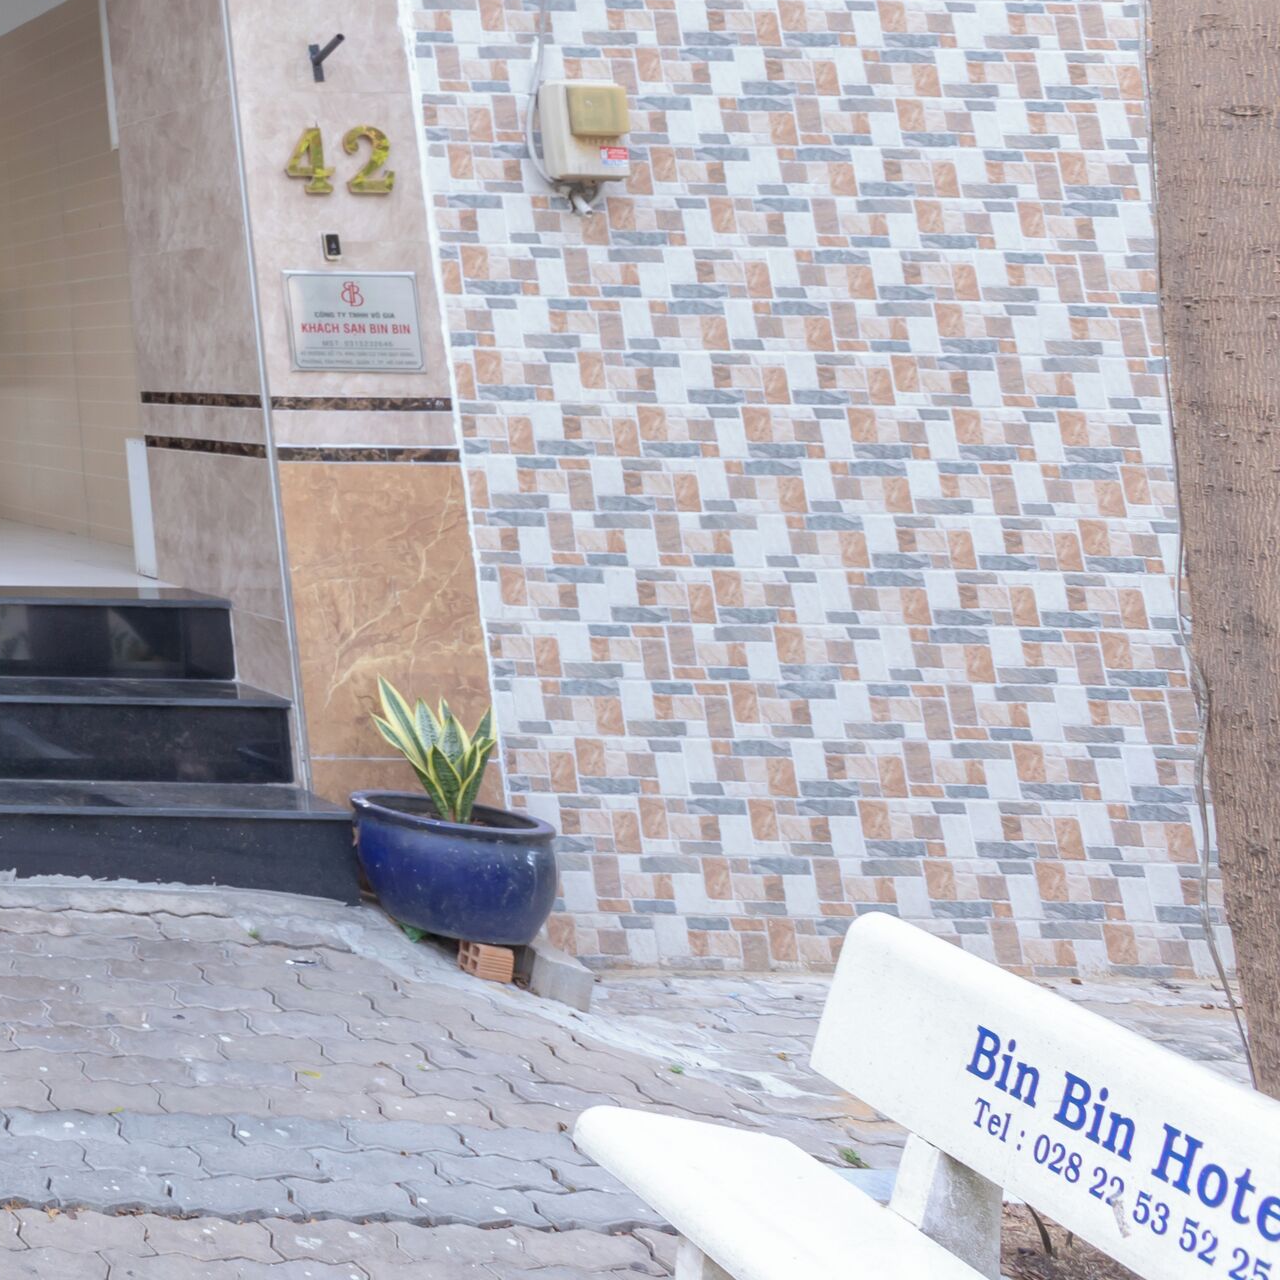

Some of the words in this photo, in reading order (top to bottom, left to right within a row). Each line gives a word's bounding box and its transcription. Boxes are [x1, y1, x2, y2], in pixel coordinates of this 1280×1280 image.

[284, 125, 396, 196] 42
[369, 323, 388, 334] BIN
[392, 323, 411, 334] BIN
[966, 1025, 1040, 1109] Bin
[1053, 1071, 1136, 1162] Bin
[1033, 1134, 1082, 1183] 028
[1088, 1166, 1125, 1207] 22
[1132, 1190, 1170, 1235] 53
[1178, 1217, 1218, 1266] 52
[1228, 1247, 1273, 1280] 25
